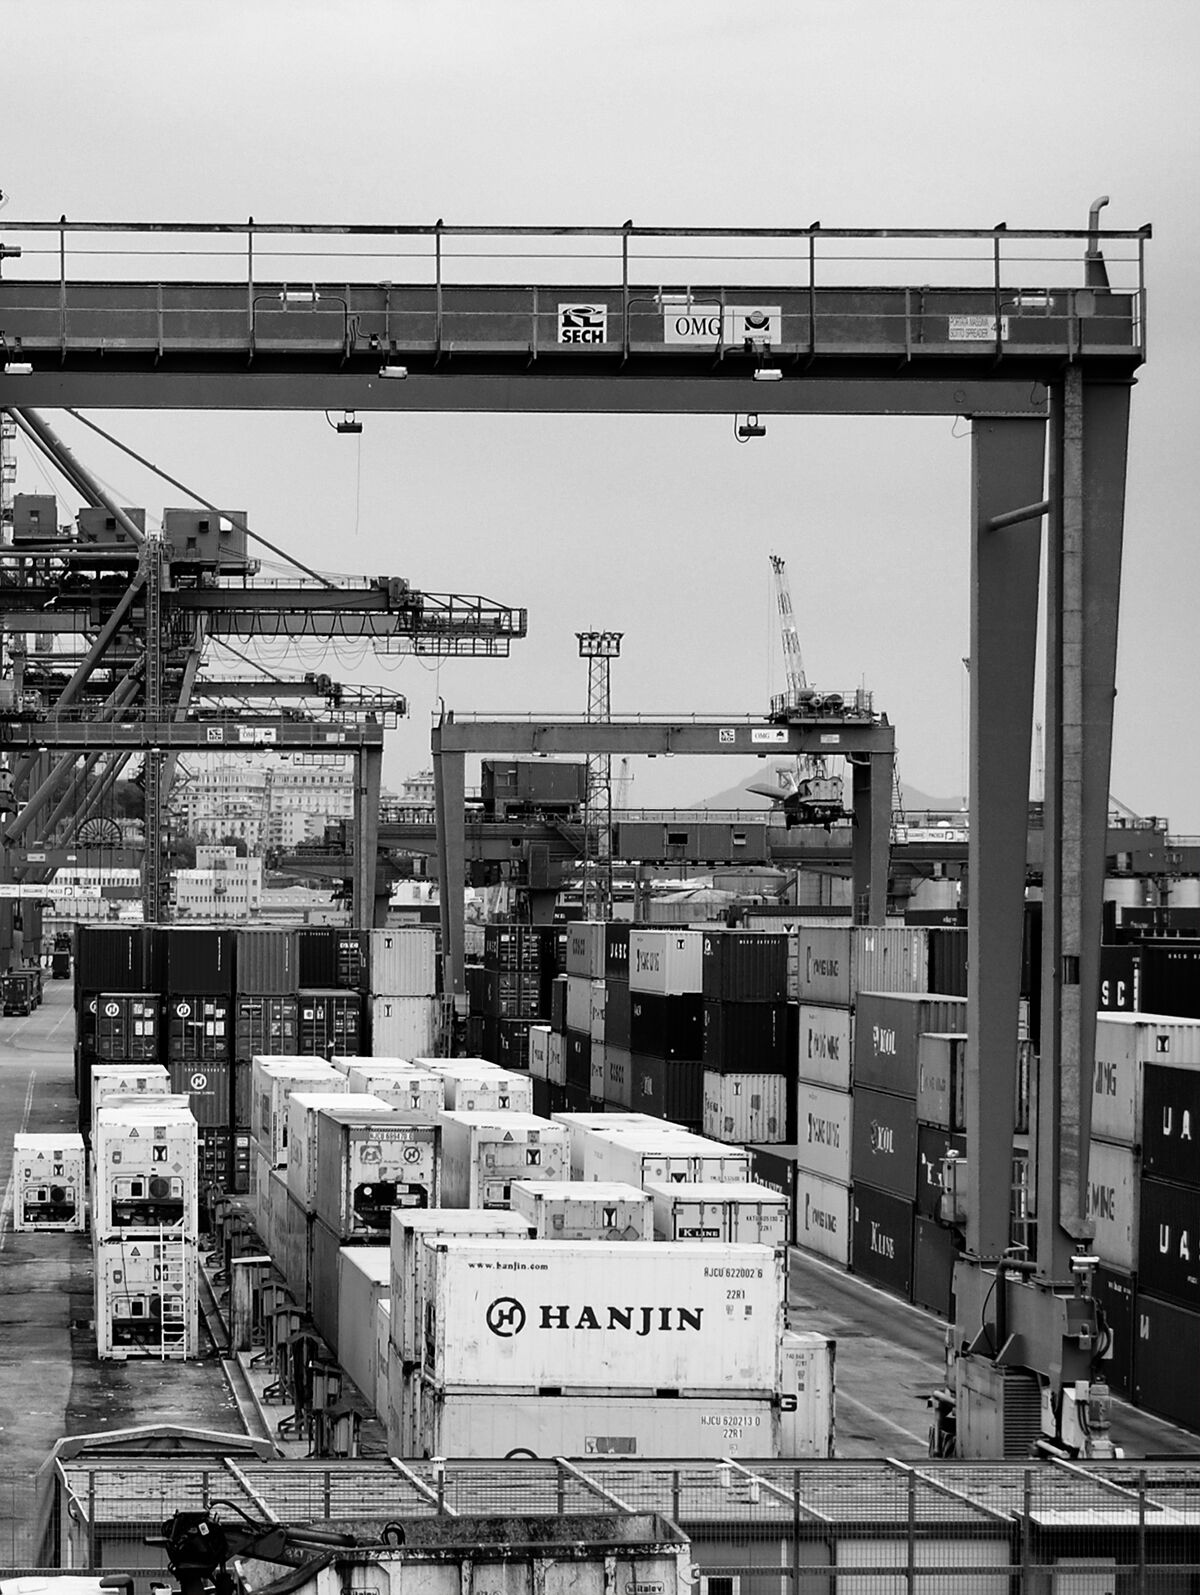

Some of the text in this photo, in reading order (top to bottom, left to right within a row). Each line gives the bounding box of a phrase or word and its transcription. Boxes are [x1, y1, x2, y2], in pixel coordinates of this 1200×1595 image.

[675, 317, 721, 336] OMG
[562, 329, 604, 344] SECH
[725, 1267, 754, 1279] 622002
[726, 1289, 746, 1300] 22R1
[539, 1305, 704, 1337] HANJIN
[701, 1416, 721, 1426] HJCU
[723, 1416, 752, 1427] 620213
[723, 1429, 743, 1439] 22R1
